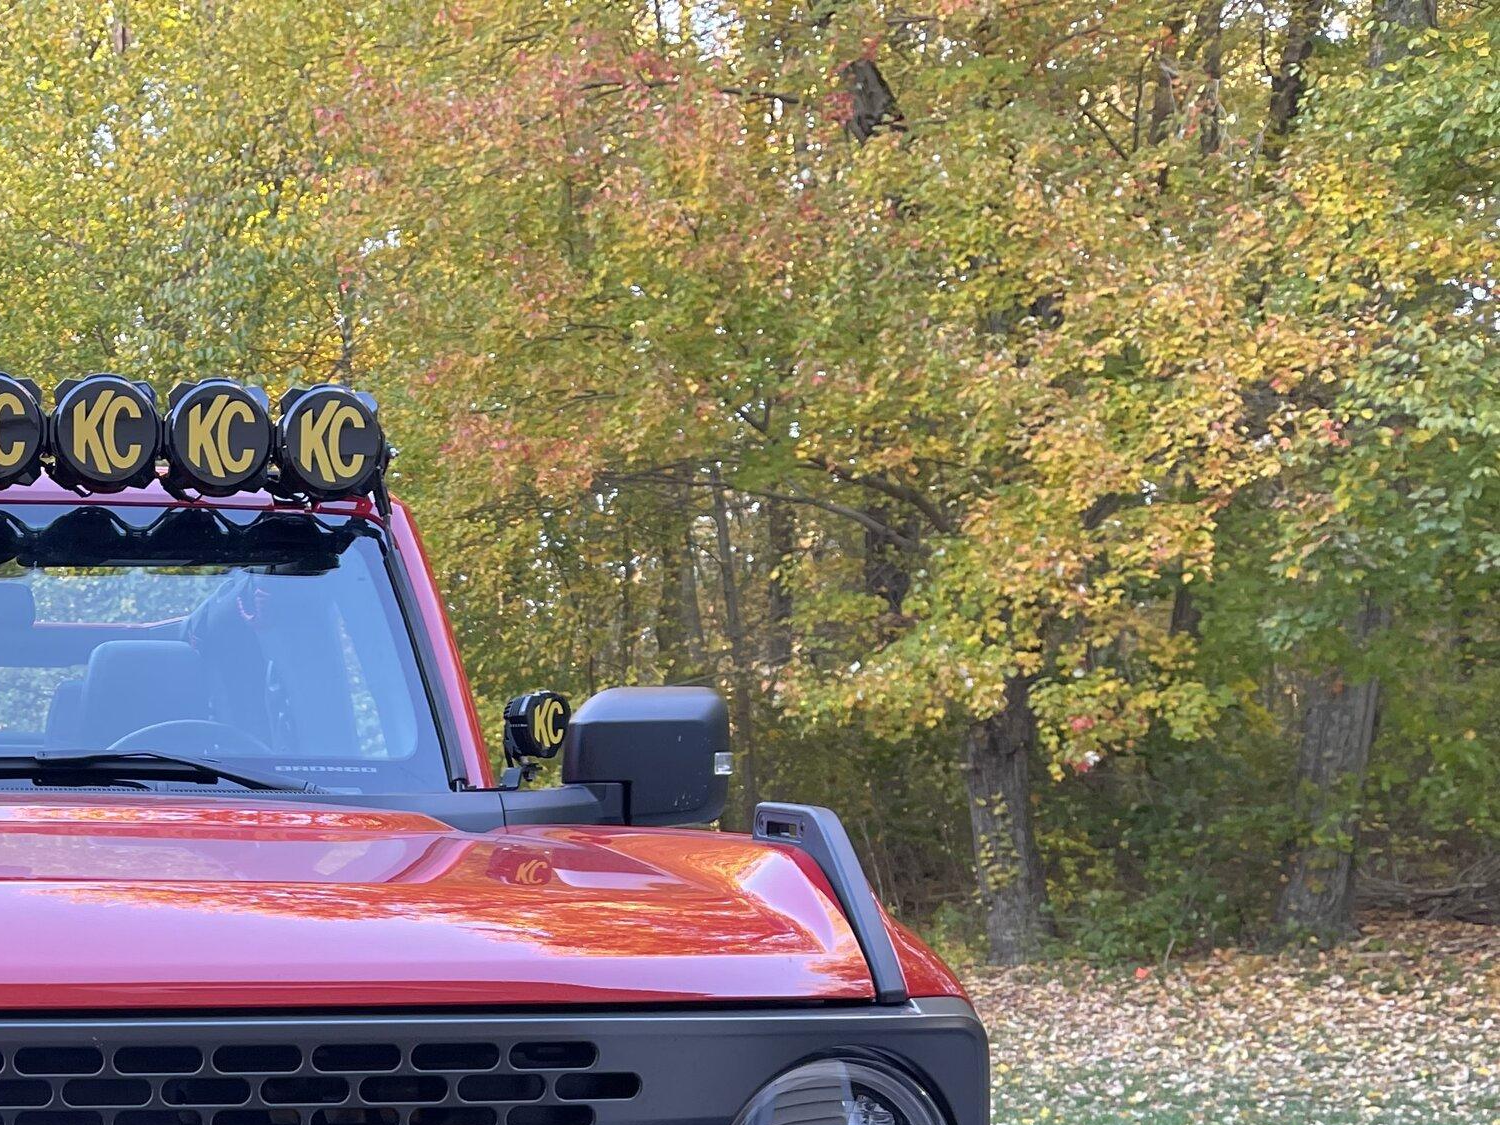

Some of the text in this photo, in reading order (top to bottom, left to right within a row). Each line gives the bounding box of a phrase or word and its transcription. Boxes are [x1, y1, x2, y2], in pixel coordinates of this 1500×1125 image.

[73, 389, 142, 474] KC
[188, 394, 256, 478] KC
[299, 399, 366, 483] KC
[534, 698, 563, 747] KC
